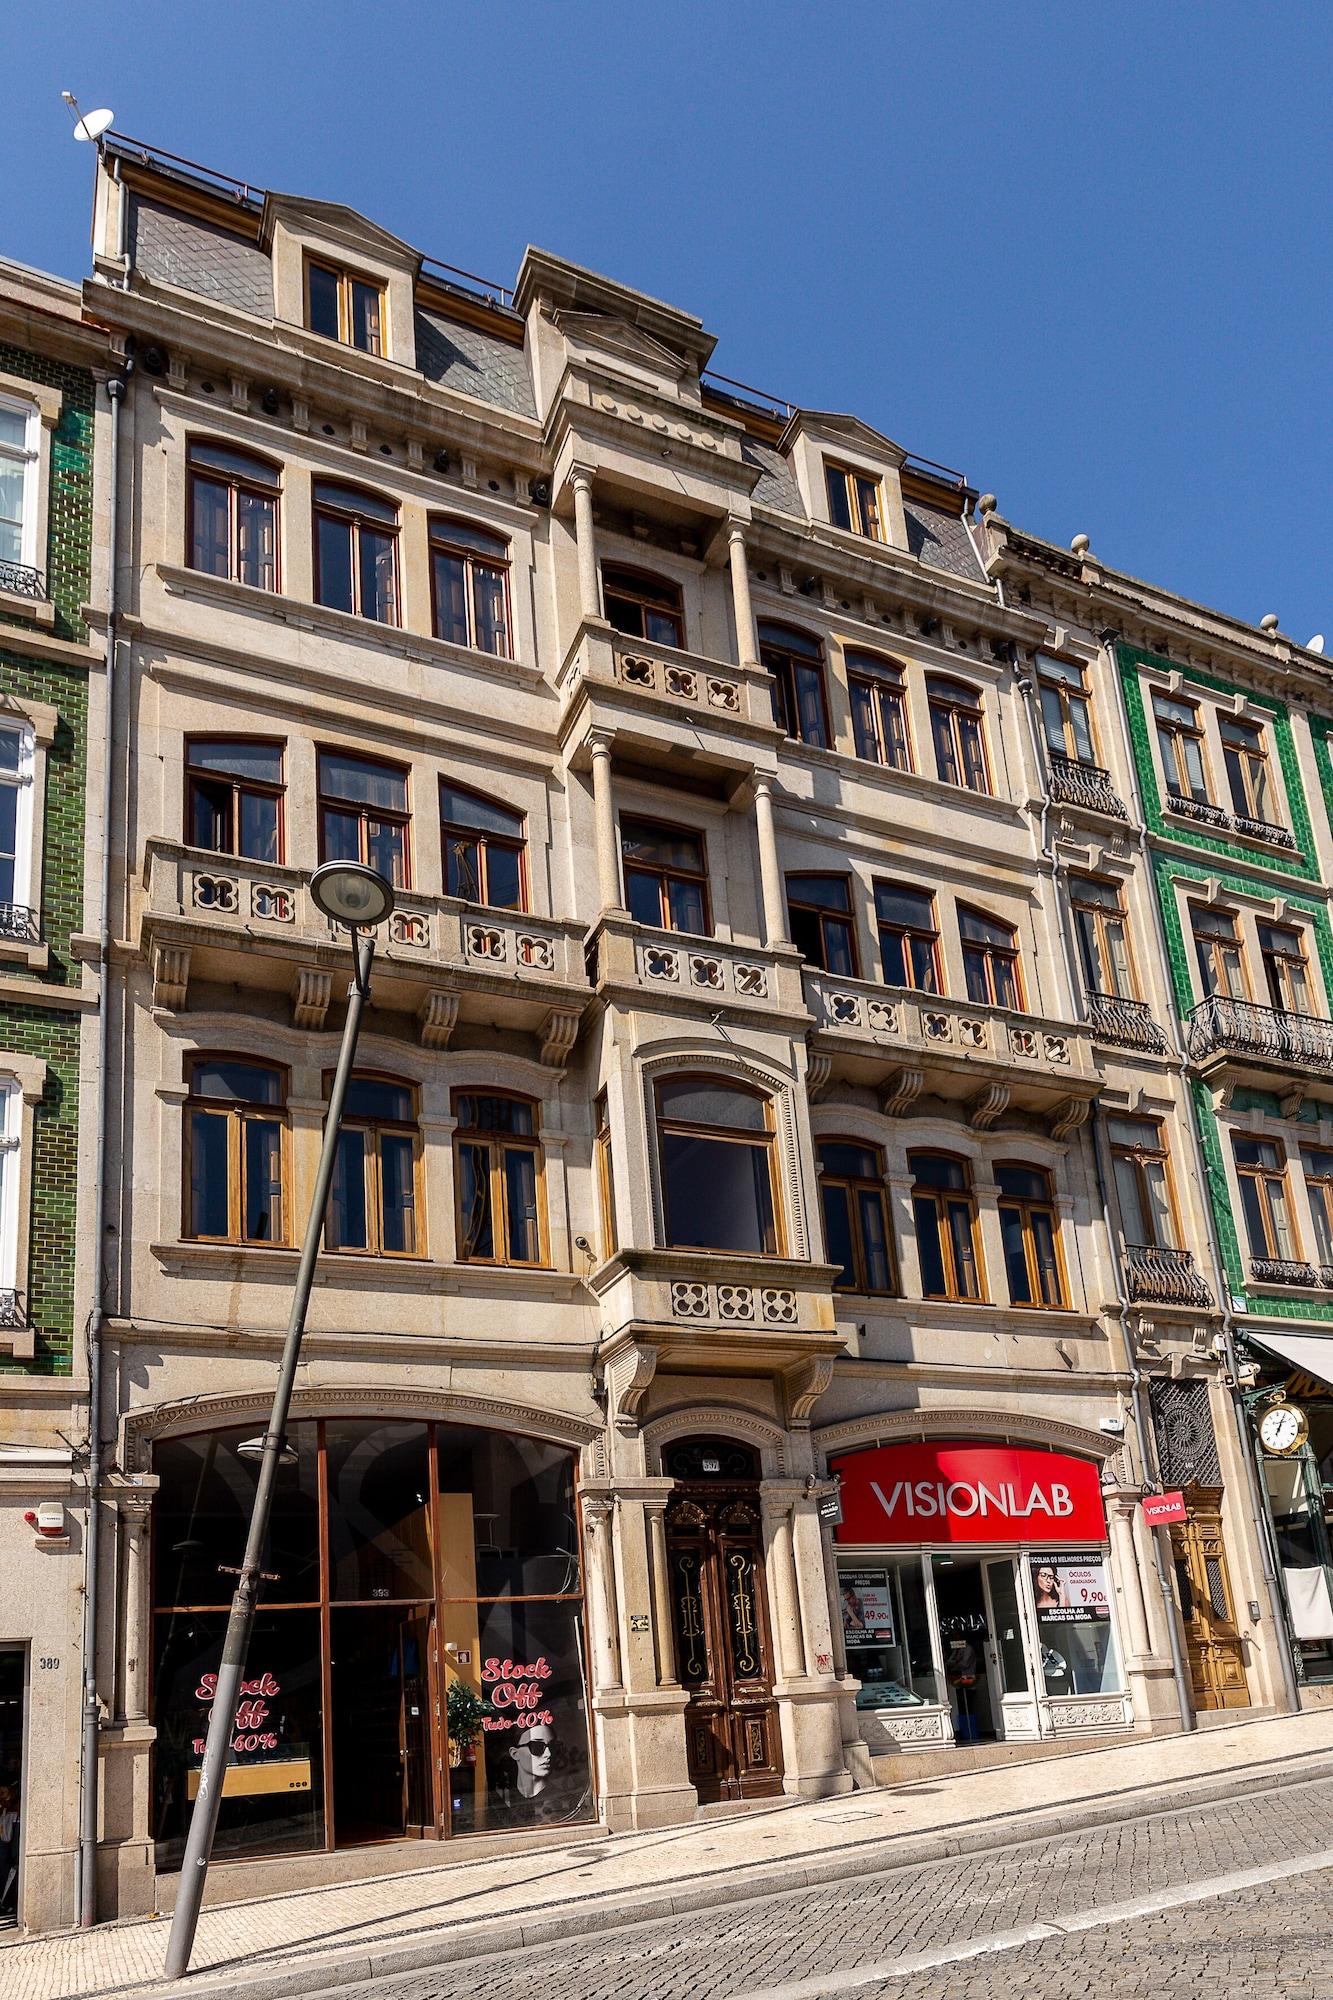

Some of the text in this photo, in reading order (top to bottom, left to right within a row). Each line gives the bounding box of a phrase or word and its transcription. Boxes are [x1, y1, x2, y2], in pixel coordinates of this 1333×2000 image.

[869, 1481, 1074, 1518] VISIONLAB
[1146, 1502, 1182, 1515] VISIONLAB
[1083, 1555, 1102, 1564] PREÇOS
[1069, 1570, 1092, 1578] ÓCULOS
[372, 1588, 390, 1597] 393
[40, 1657, 60, 1670] 389
[481, 1657, 552, 1682] Stock
[195, 1672, 280, 1700] Sock
[491, 1682, 543, 1709] Off
[481, 1709, 553, 1731] Tudo-60%
